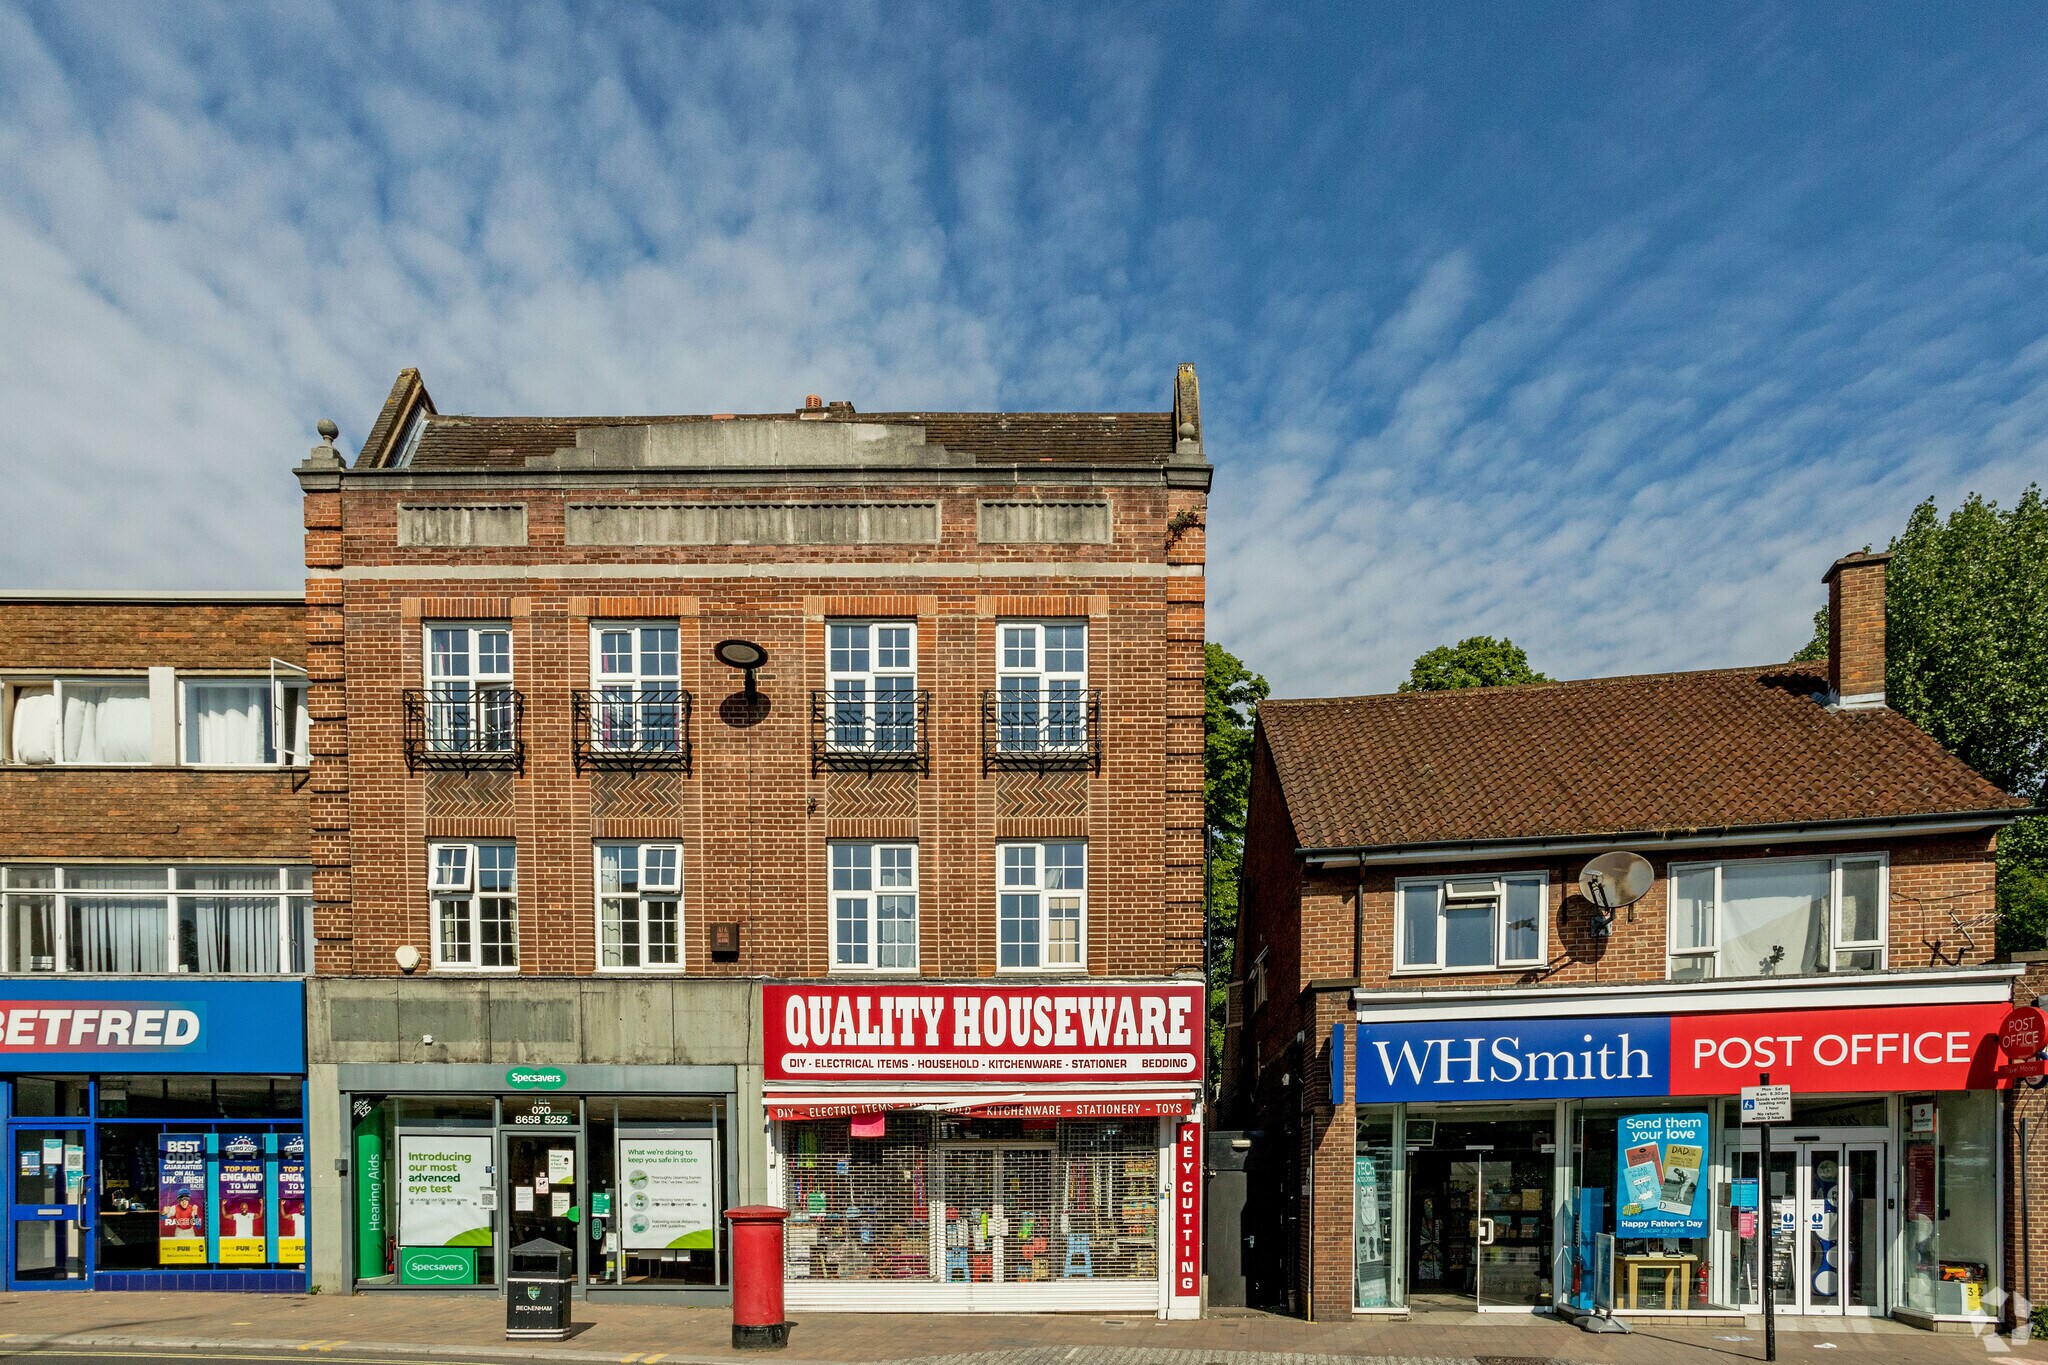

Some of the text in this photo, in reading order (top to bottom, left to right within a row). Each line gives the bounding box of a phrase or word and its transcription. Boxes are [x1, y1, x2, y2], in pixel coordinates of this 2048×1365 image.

[785, 994, 1192, 1048] QUALITY HOUSEWARE
[2009, 1017, 2035, 1032] POST
[0, 1009, 200, 1046] ETFRED
[2003, 1031, 2039, 1047] OFFICE
[1694, 1031, 1971, 1069] POST OFFICE
[789, 1058, 1188, 1069] DIY ELECTRICAL ITEMS HOUSEHOLD KITCHENWARE STATIONER BEDDING
[1372, 1033, 1653, 1086] WHSmith
[512, 1073, 561, 1083] Specsavers
[532, 1106, 551, 1114] 020
[777, 1102, 894, 1118] DIY ELECTRIC ITEMS
[986, 1103, 1182, 1116] KITCHENWARE STATIONERY TOYS
[515, 1116, 568, 1124] 8658 5252
[1626, 1117, 1702, 1129] Send them
[1632, 1129, 1696, 1142] your love
[167, 1141, 200, 1152] BEST
[1671, 1146, 1689, 1156] DAD
[166, 1153, 202, 1164] ODDS
[408, 1152, 472, 1163] Introducing
[430, 1163, 457, 1171] most
[162, 1176, 176, 1184] UK
[183, 1176, 204, 1184] IRISH
[220, 1173, 263, 1182] ENGLAND
[408, 1173, 461, 1182] advanced
[368, 1154, 381, 1231] Hearing Aids
[408, 1184, 452, 1194] eye test
[1181, 1130, 1194, 1289] KEY CUTTING
[165, 1218, 189, 1226] RACE
[1621, 1220, 1648, 1229] Happy
[1686, 1220, 1703, 1228] Day
[412, 1262, 463, 1271] Specsavers
[1968, 1288, 1983, 1296] 3 2
